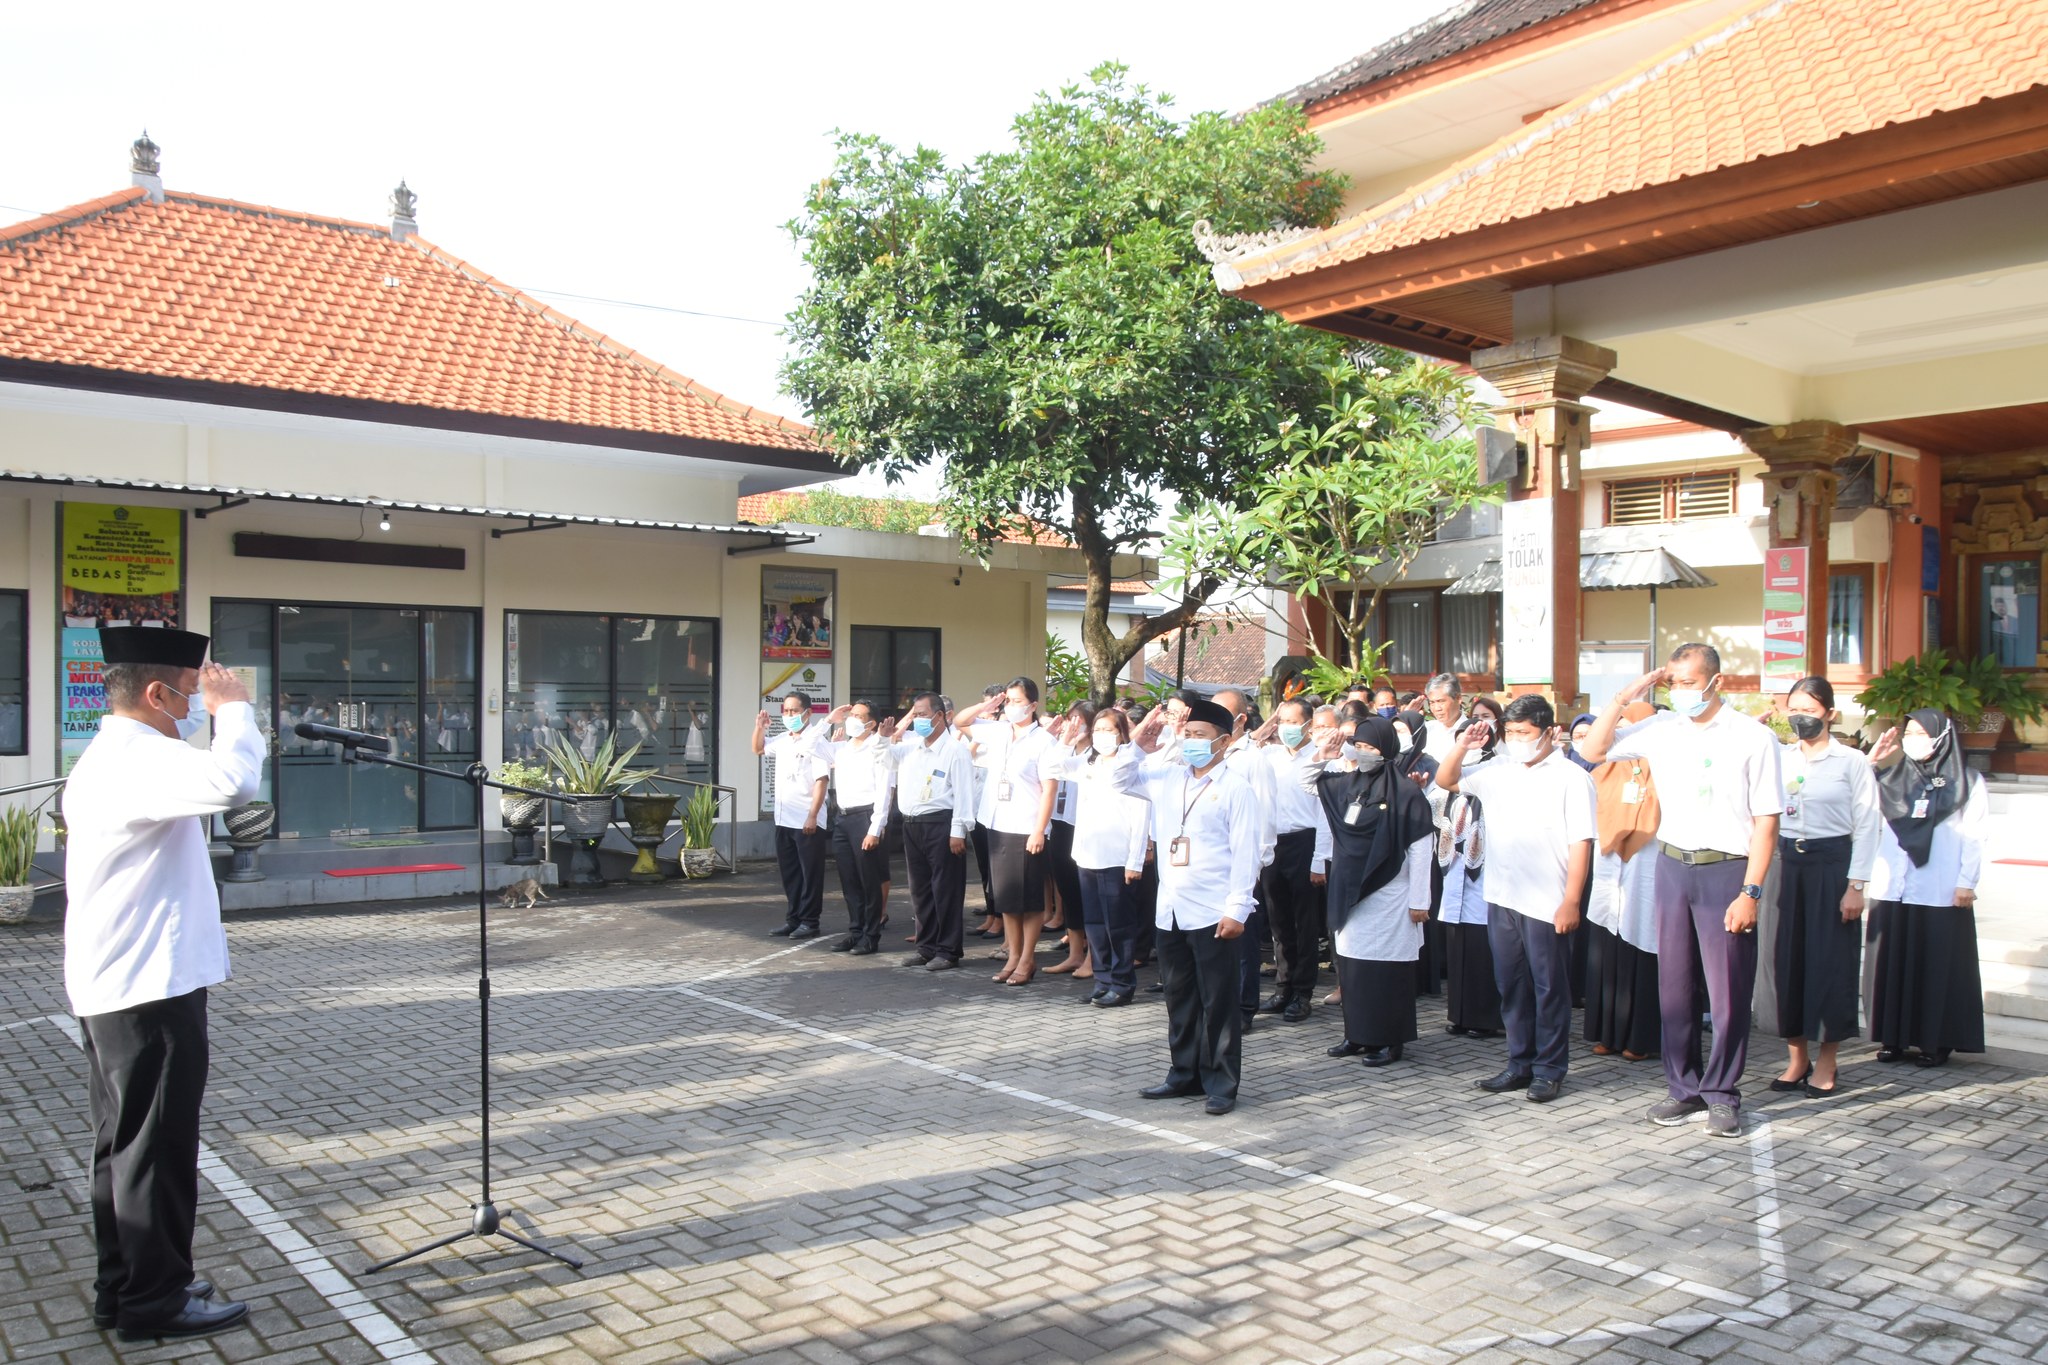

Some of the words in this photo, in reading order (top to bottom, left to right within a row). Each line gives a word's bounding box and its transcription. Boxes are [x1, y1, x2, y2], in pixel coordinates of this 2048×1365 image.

[1512, 531, 1541, 548] Kami
[107, 554, 142, 563] TANPA
[144, 556, 175, 565] BIAYA
[1508, 548, 1544, 569] TOLAK
[71, 568, 121, 579] BEBAS
[1508, 570, 1546, 587] PUNGLI
[66, 660, 105, 672] CEP
[765, 695, 784, 703] Stan
[63, 722, 101, 732] TANPA
